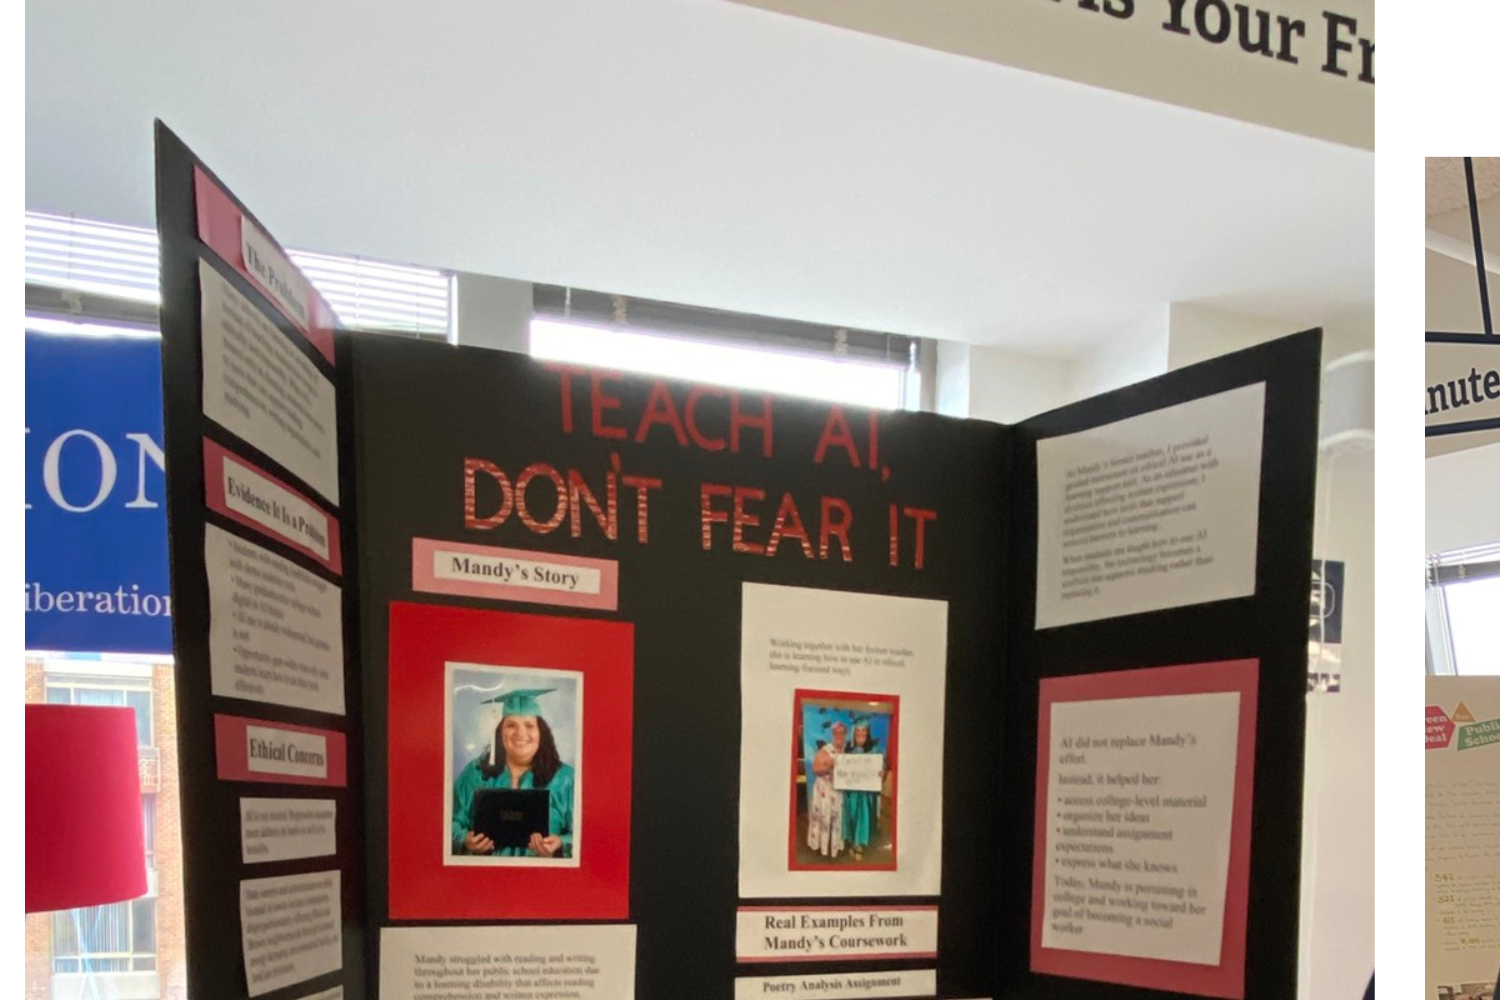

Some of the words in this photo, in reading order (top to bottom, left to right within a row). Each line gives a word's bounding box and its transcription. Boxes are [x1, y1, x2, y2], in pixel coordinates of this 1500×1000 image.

[1425, 367, 1500, 416] nute
[543, 363, 773, 458] TEACH
[813, 407, 892, 482] AI,
[228, 476, 271, 516] Evidence
[463, 454, 662, 543] DON'T
[701, 484, 853, 562] FEAR
[889, 504, 937, 570] IT
[532, 567, 580, 589] Story
[1425, 715, 1448, 724] een
[1061, 738, 1073, 748] AI
[1075, 736, 1090, 748] did
[1092, 737, 1108, 747] not
[1110, 735, 1146, 750] replace
[249, 738, 286, 762] Ethical
[288, 744, 324, 766] Concerns
[1106, 774, 1139, 787] helped
[1064, 797, 1093, 806] access
[1163, 796, 1207, 808] material
[1063, 811, 1103, 824] organize
[1106, 810, 1121, 823] her
[1124, 812, 1150, 823] ideas
[1063, 827, 1114, 838] understand
[1099, 858, 1122, 871] what
[1124, 860, 1141, 872] she
[1144, 860, 1178, 874] knows
[1088, 877, 1121, 892] Mandy
[1088, 895, 1106, 906] and
[1108, 897, 1148, 911] working
[1189, 902, 1207, 915] her
[764, 915, 796, 930] Real
[800, 914, 865, 931] Examples
[869, 914, 904, 928] From
[829, 934, 907, 949] Coursework
[415, 954, 446, 965] Mandy
[450, 954, 491, 965] struggled
[493, 954, 513, 964] with
[515, 954, 546, 966] reading
[548, 954, 564, 963] and
[566, 954, 595, 965] writing
[414, 967, 464, 978] throughout
[466, 966, 481, 977] her
[483, 966, 510, 978] public
[512, 966, 541, 976] school
[763, 981, 796, 994] Poetry
[800, 979, 843, 992] Analysis
[845, 977, 901, 990] Assignment
